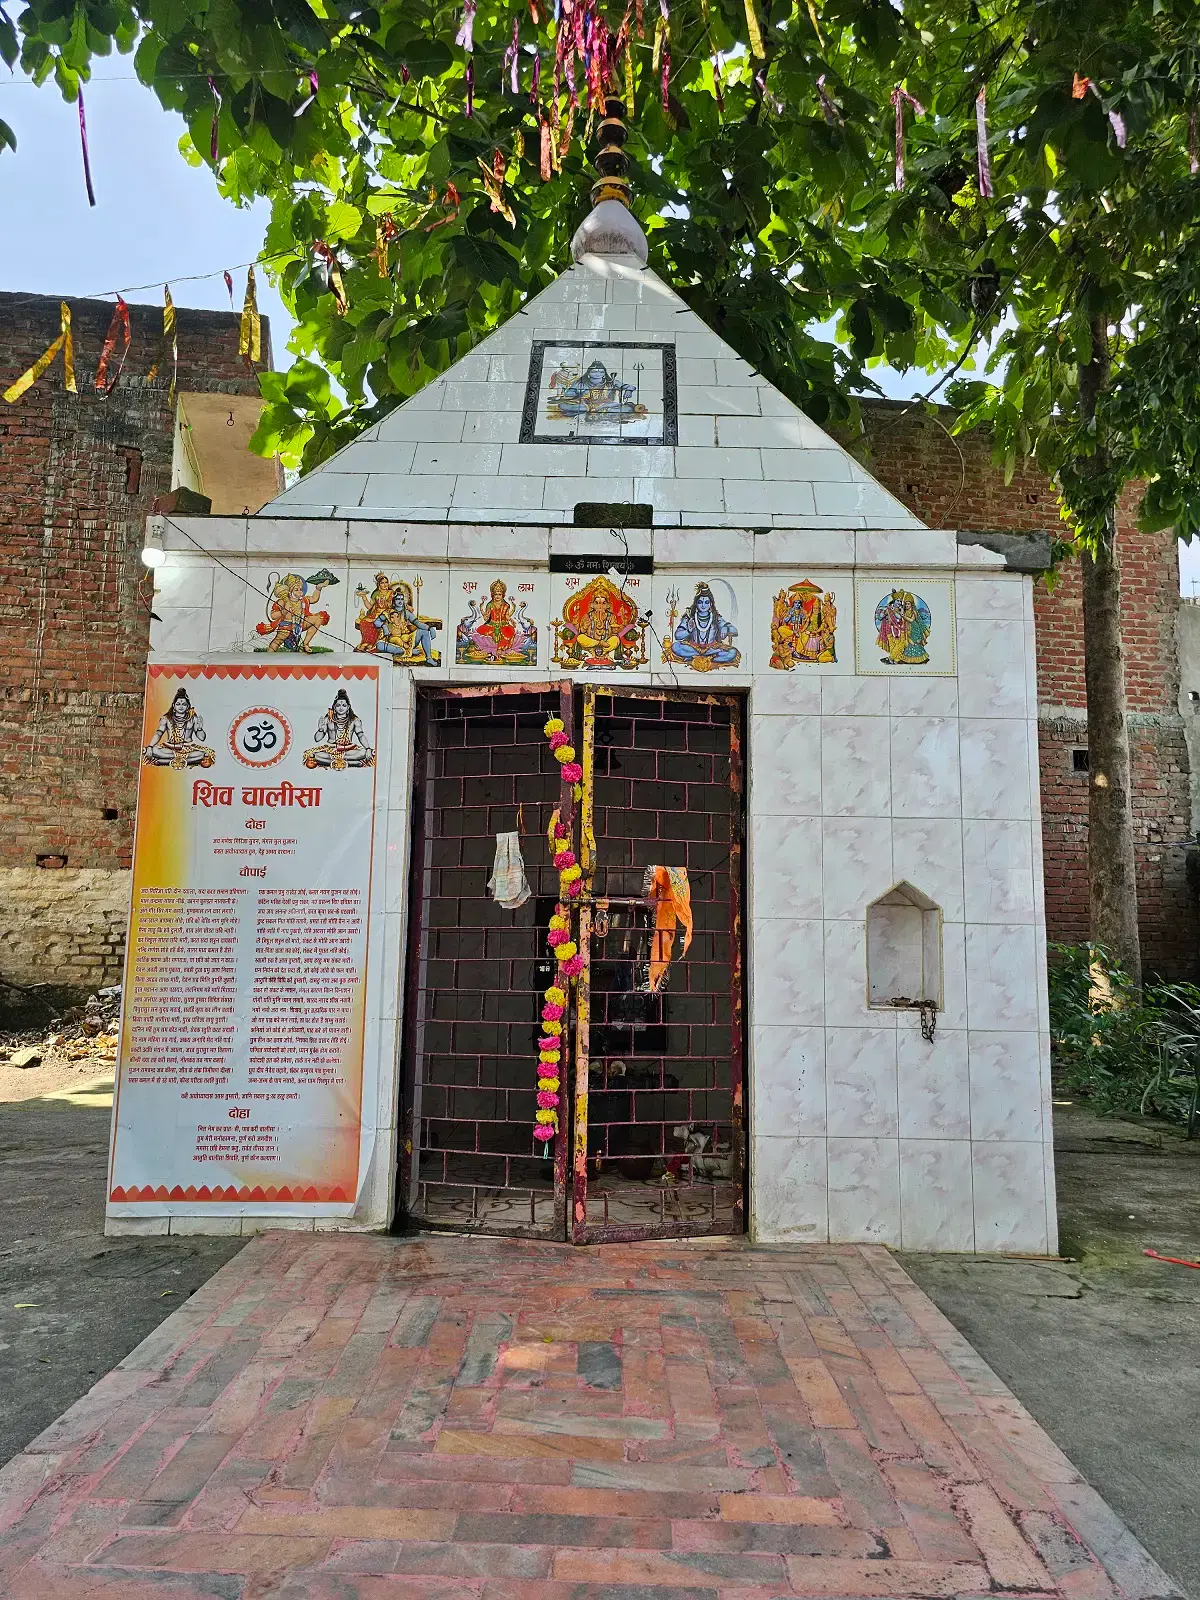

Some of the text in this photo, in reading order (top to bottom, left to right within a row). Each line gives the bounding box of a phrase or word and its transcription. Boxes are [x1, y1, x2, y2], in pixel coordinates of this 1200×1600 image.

[586, 560, 601, 570] नमः
[462, 581, 478, 594] शुभ
[518, 582, 534, 592] लाभ
[565, 577, 580, 590] शुभ
[192, 779, 323, 809] शिव चालीसा
[245, 818, 266, 830] दोहा
[239, 865, 267, 878] चौपाई
[228, 1106, 250, 1118] दोहा
